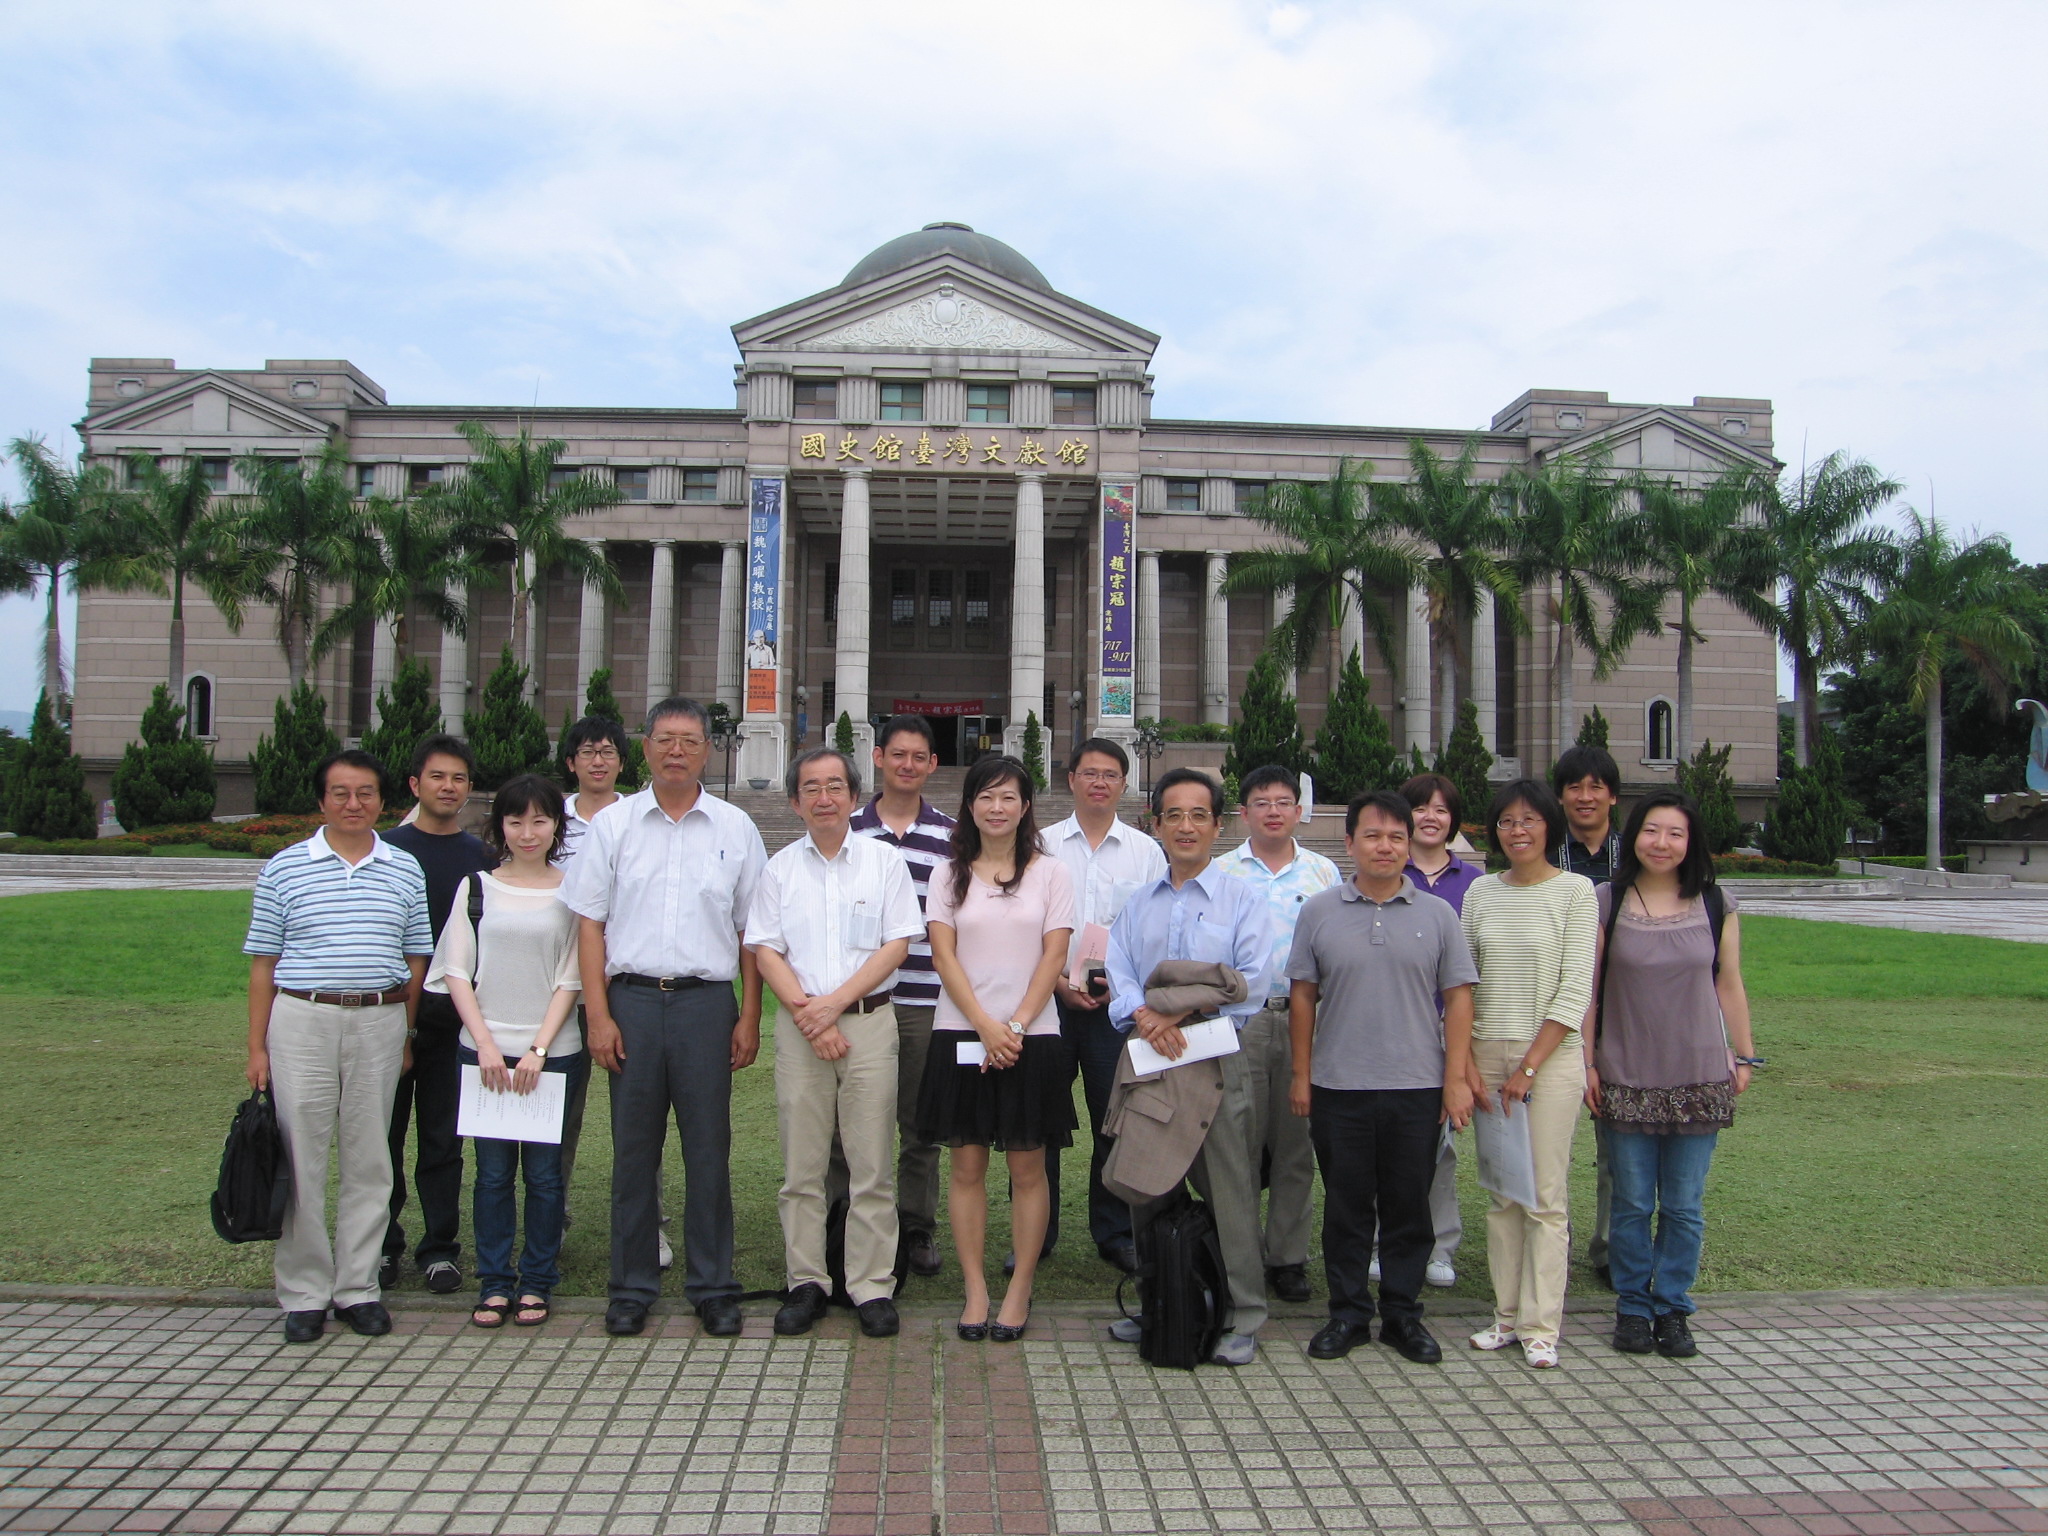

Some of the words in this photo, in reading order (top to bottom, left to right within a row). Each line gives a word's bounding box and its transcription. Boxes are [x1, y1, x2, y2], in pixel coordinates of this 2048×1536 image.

[800, 432, 1089, 466] 國史館臺灣文獻館
[752, 535, 766, 610] 魏火曜教授
[1109, 556, 1126, 606] 趙宗冠
